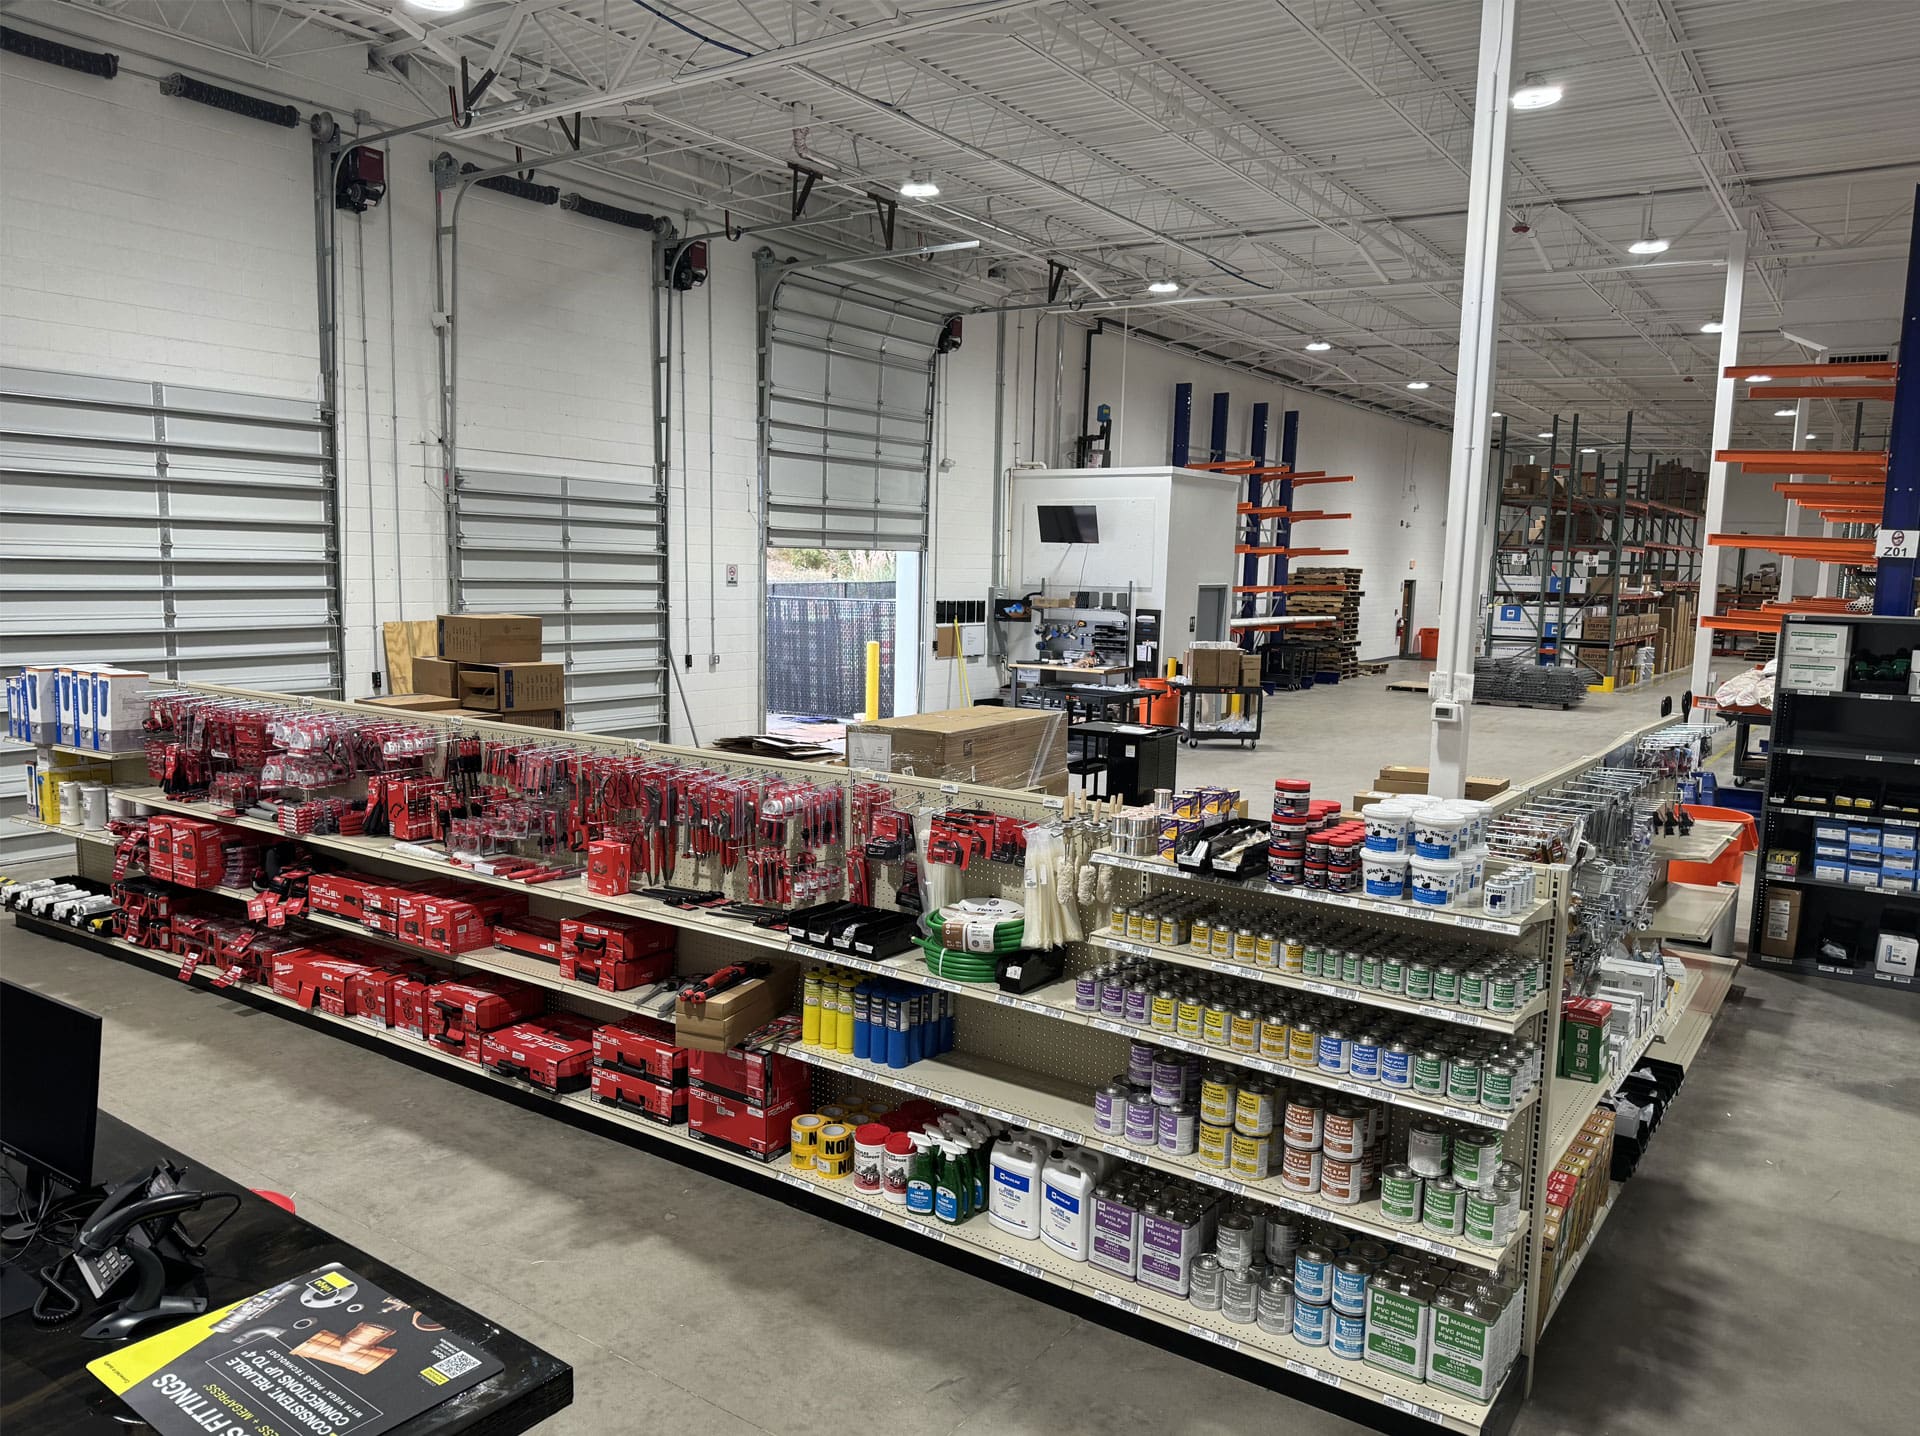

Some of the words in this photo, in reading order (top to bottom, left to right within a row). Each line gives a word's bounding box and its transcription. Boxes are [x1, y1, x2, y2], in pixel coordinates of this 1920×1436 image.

[1883, 547, 1907, 556] Z01
[701, 1091, 725, 1105] FUEL
[1375, 1305, 1390, 1314] PVC
[1391, 1309, 1414, 1323] Plastic
[1385, 1298, 1417, 1314] MAINLINE
[1373, 1311, 1389, 1321] Pipe
[1389, 1315, 1415, 1330] Cement
[1450, 1319, 1482, 1334] MAINLINE
[1438, 1331, 1454, 1342] Pipe
[1454, 1336, 1481, 1351] Cement
[1440, 1325, 1455, 1335] PVC
[1456, 1330, 1480, 1344] Plastic
[252, 1356, 270, 1369] TO
[265, 1349, 304, 1376] TECHNOLOGY
[225, 1357, 275, 1392] RELIABLE
[264, 1365, 284, 1380] UP
[303, 1375, 324, 1390] PRESS
[152, 1373, 232, 1433] FITTINGS
[277, 1375, 350, 1426] CONNECTIONS
[267, 1386, 333, 1436] CONSISTENT,
[345, 1403, 363, 1418] WITH
